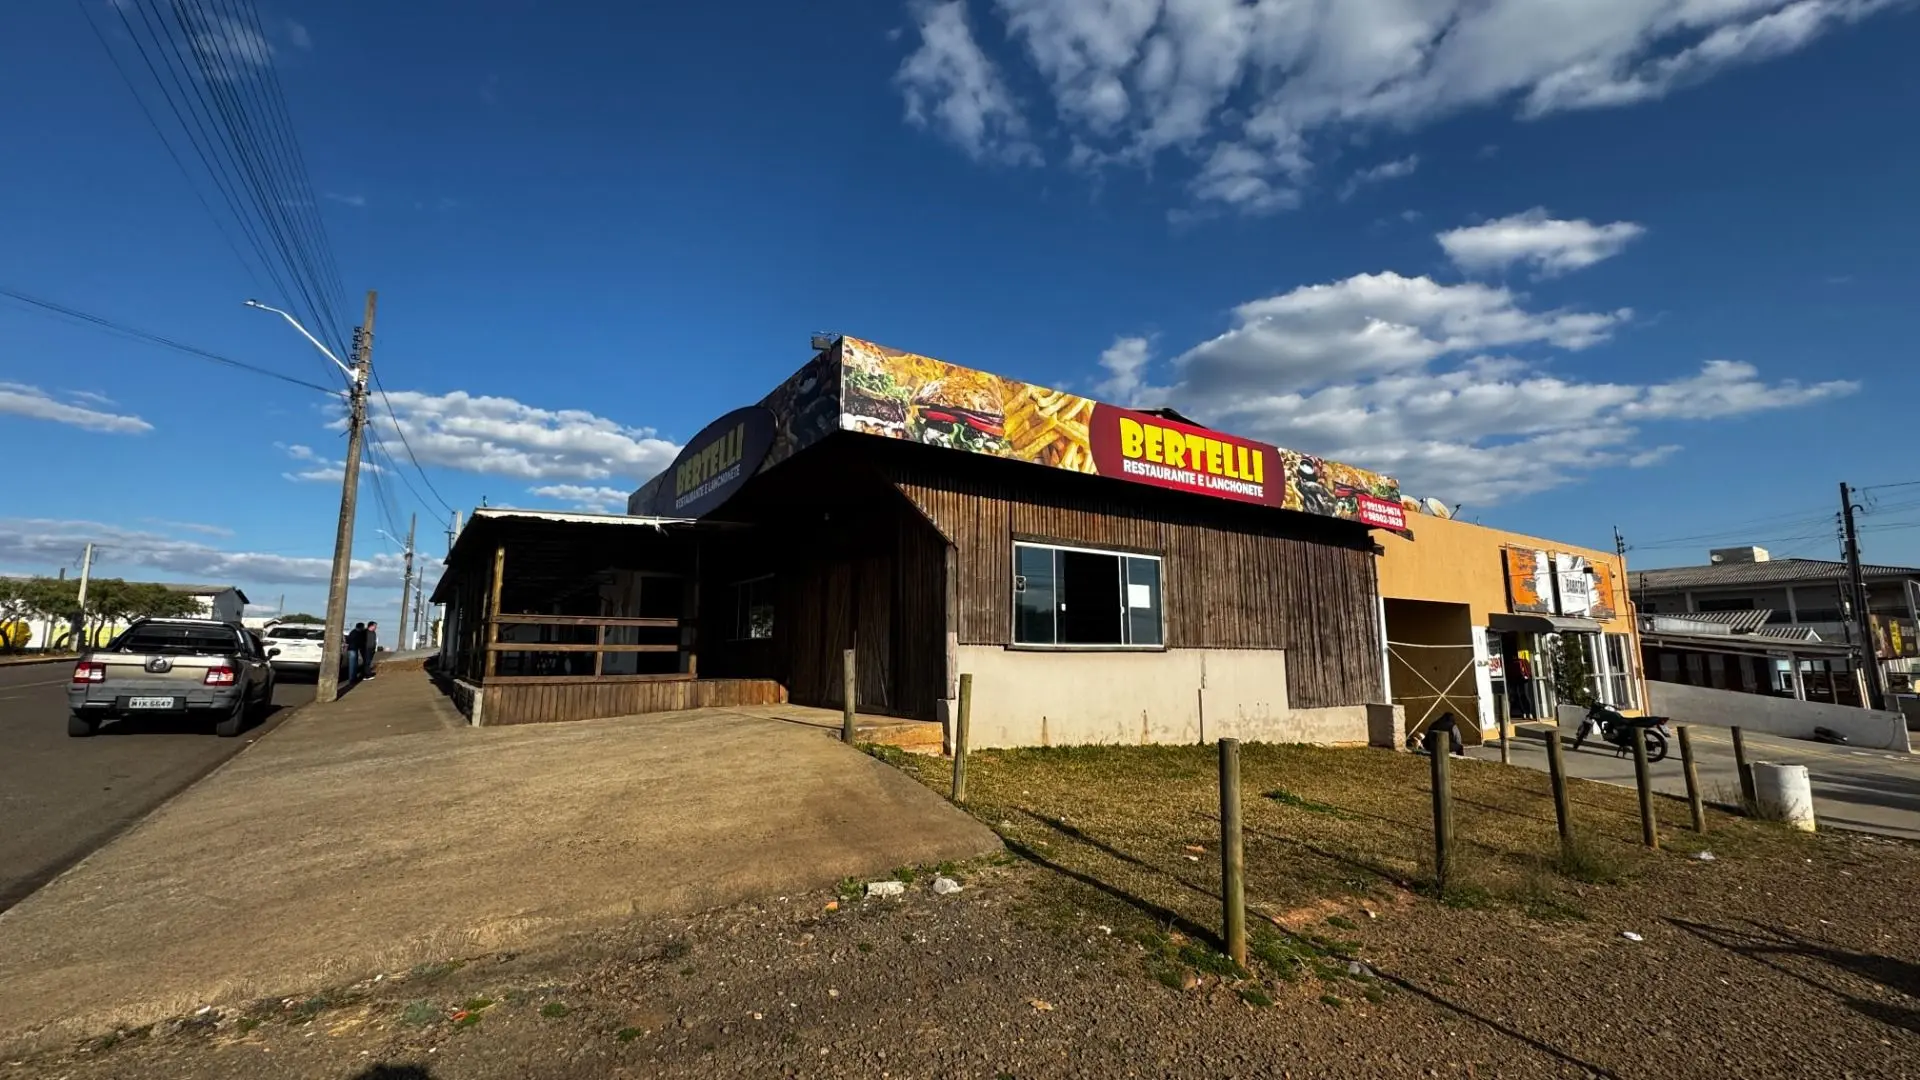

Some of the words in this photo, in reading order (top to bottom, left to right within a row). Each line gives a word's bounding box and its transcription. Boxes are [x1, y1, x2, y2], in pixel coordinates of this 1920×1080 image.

[676, 422, 744, 497] BERTELLI
[1119, 417, 1264, 484] BERTELLI
[1123, 459, 1196, 486] RESTAURANTE
[1197, 474, 1205, 488] E
[1205, 476, 1264, 498] LANCHONETE
[675, 486, 705, 510] RESTAURANTE
[708, 464, 741, 492] LANCHONETE
